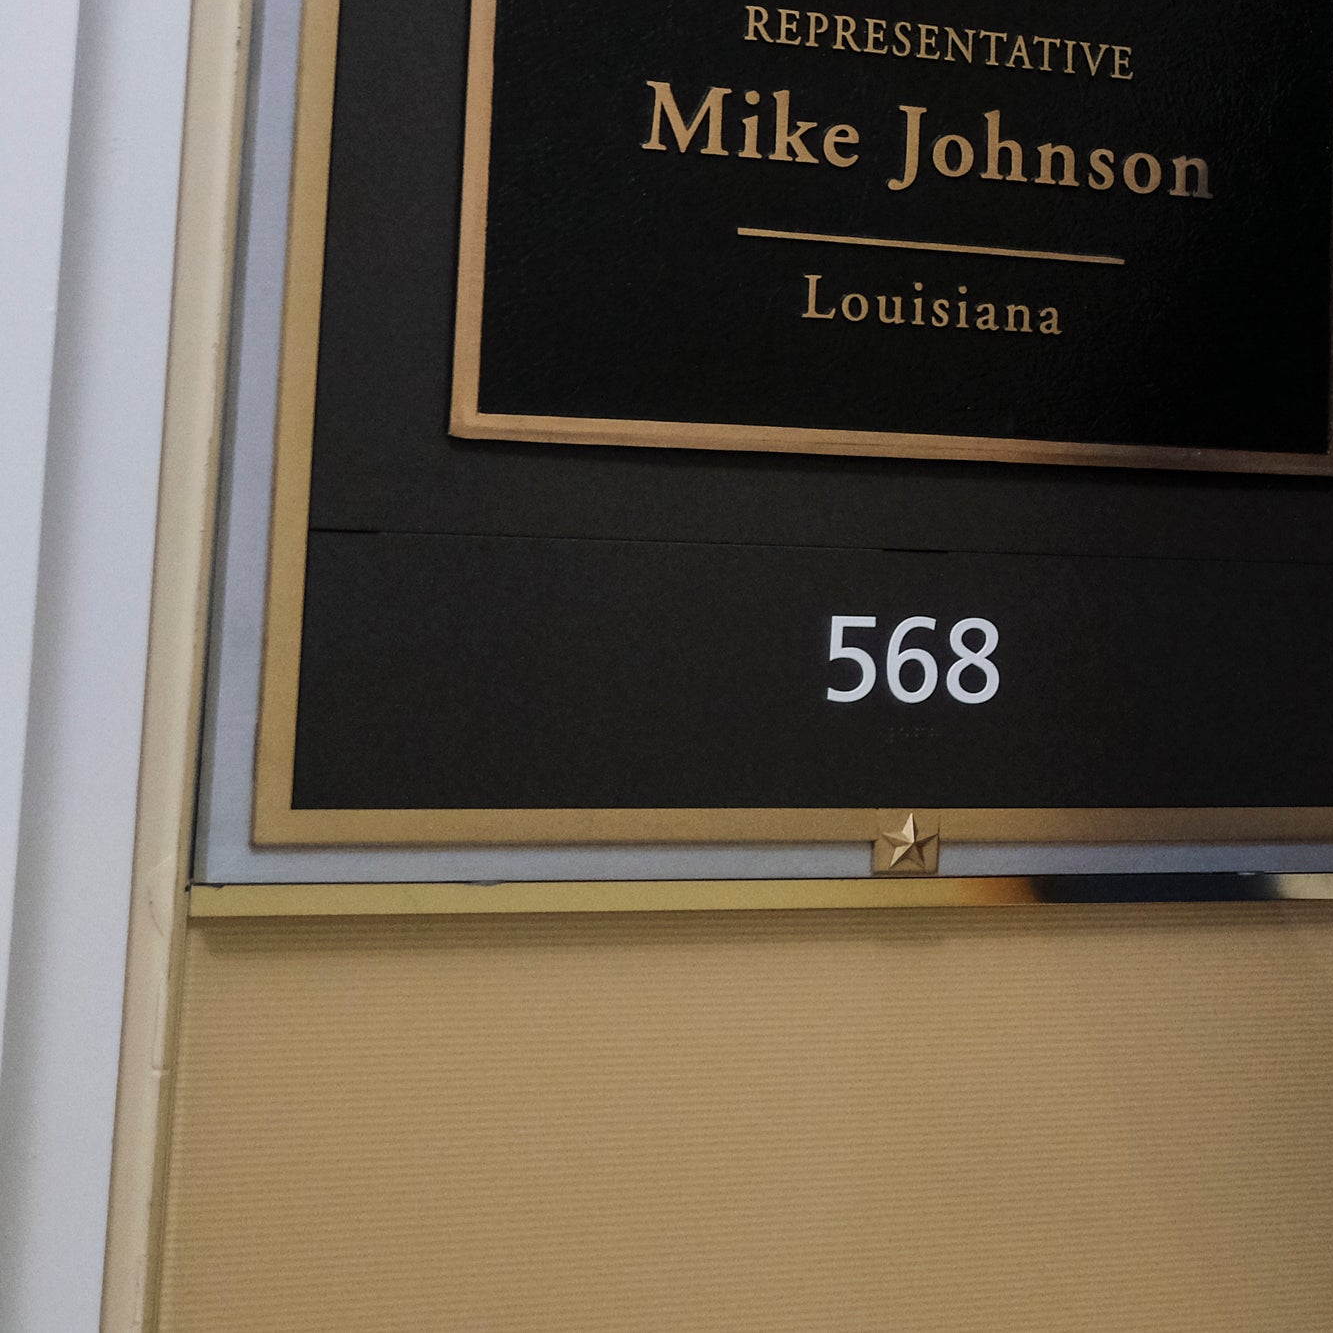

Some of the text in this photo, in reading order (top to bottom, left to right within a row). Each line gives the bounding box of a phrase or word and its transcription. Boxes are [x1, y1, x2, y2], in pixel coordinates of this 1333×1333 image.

[744, 5, 1134, 80] REPRESENTATIVE
[641, 80, 1213, 199] Mike Johnson
[801, 273, 1063, 336] Louisiana
[826, 615, 1000, 704] 568
